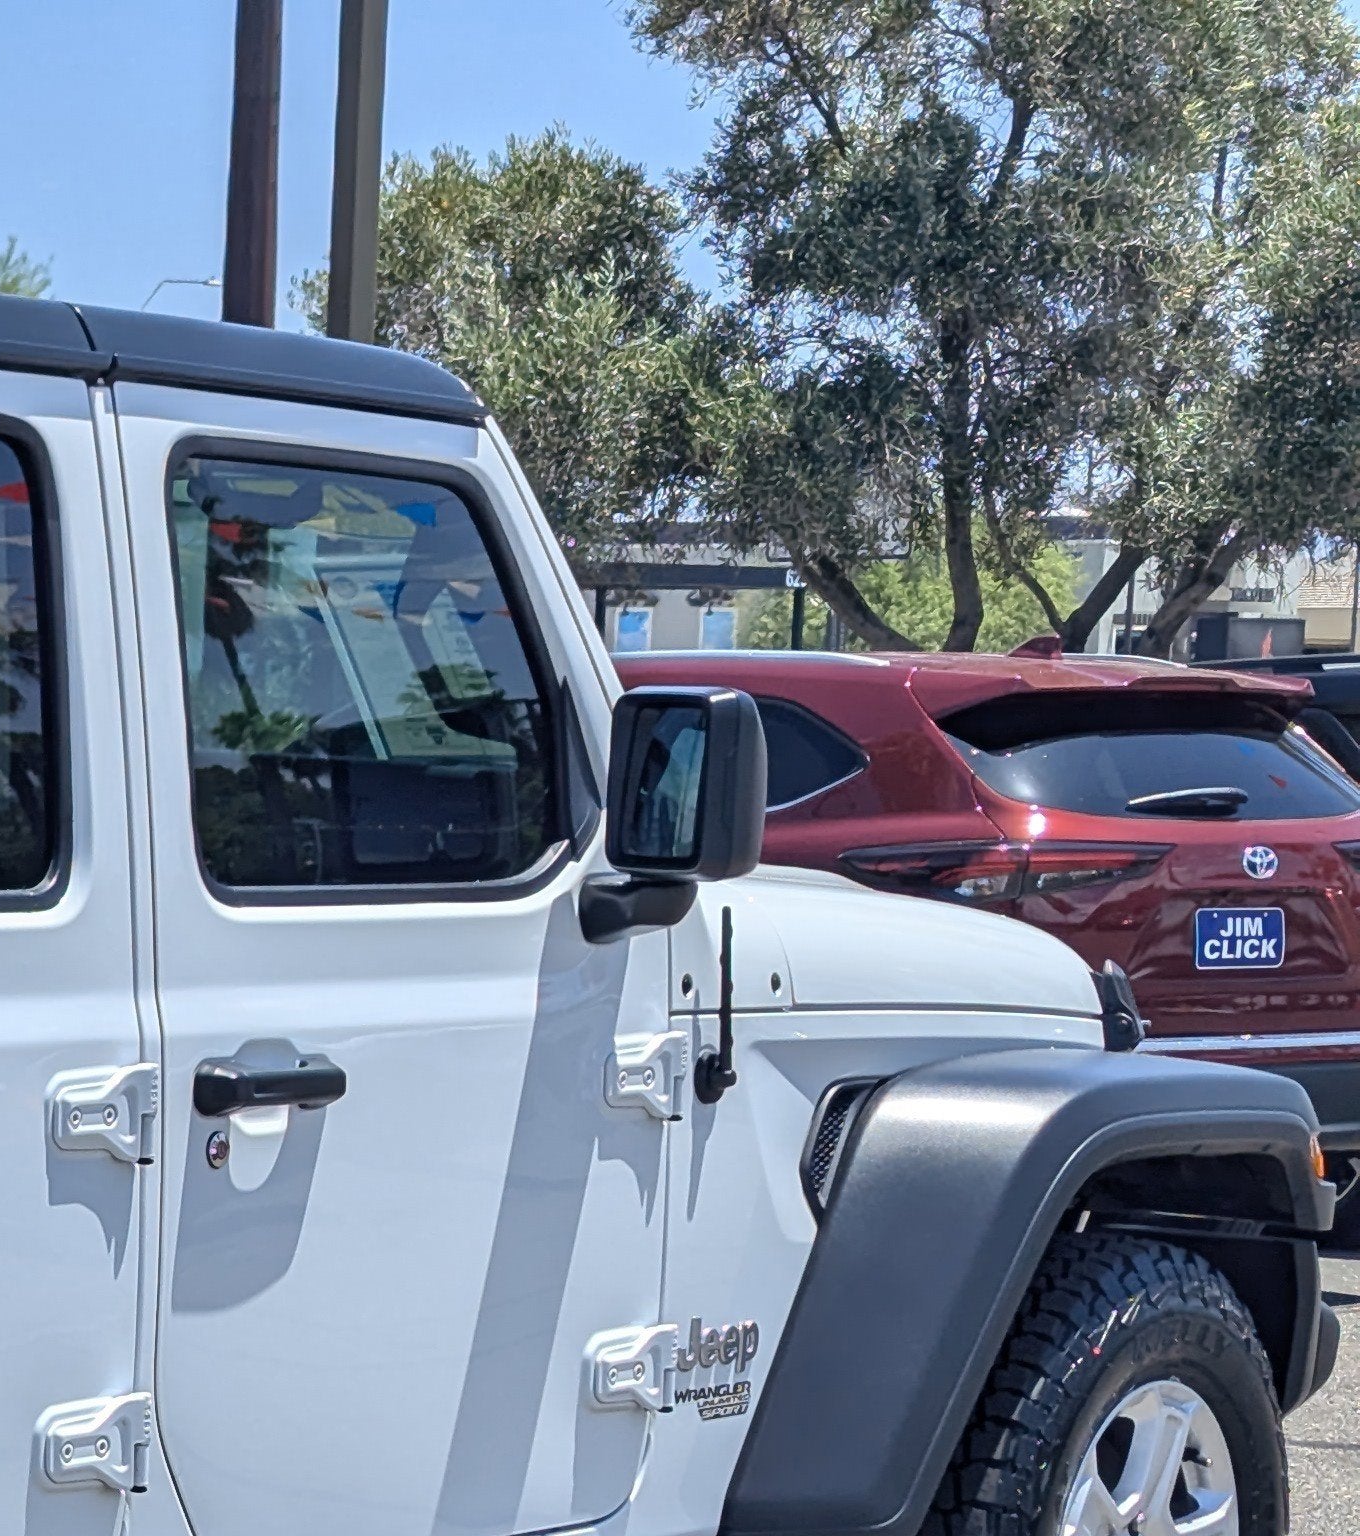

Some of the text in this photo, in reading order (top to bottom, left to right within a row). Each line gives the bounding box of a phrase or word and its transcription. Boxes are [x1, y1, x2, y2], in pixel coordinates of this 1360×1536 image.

[785, 568, 808, 588] 62
[1219, 916, 1264, 937] JIM
[1203, 938, 1278, 960] CLICK
[676, 1315, 759, 1373] Jeep
[674, 1381, 752, 1405] WRANGLER
[700, 1402, 749, 1420] SPORT
